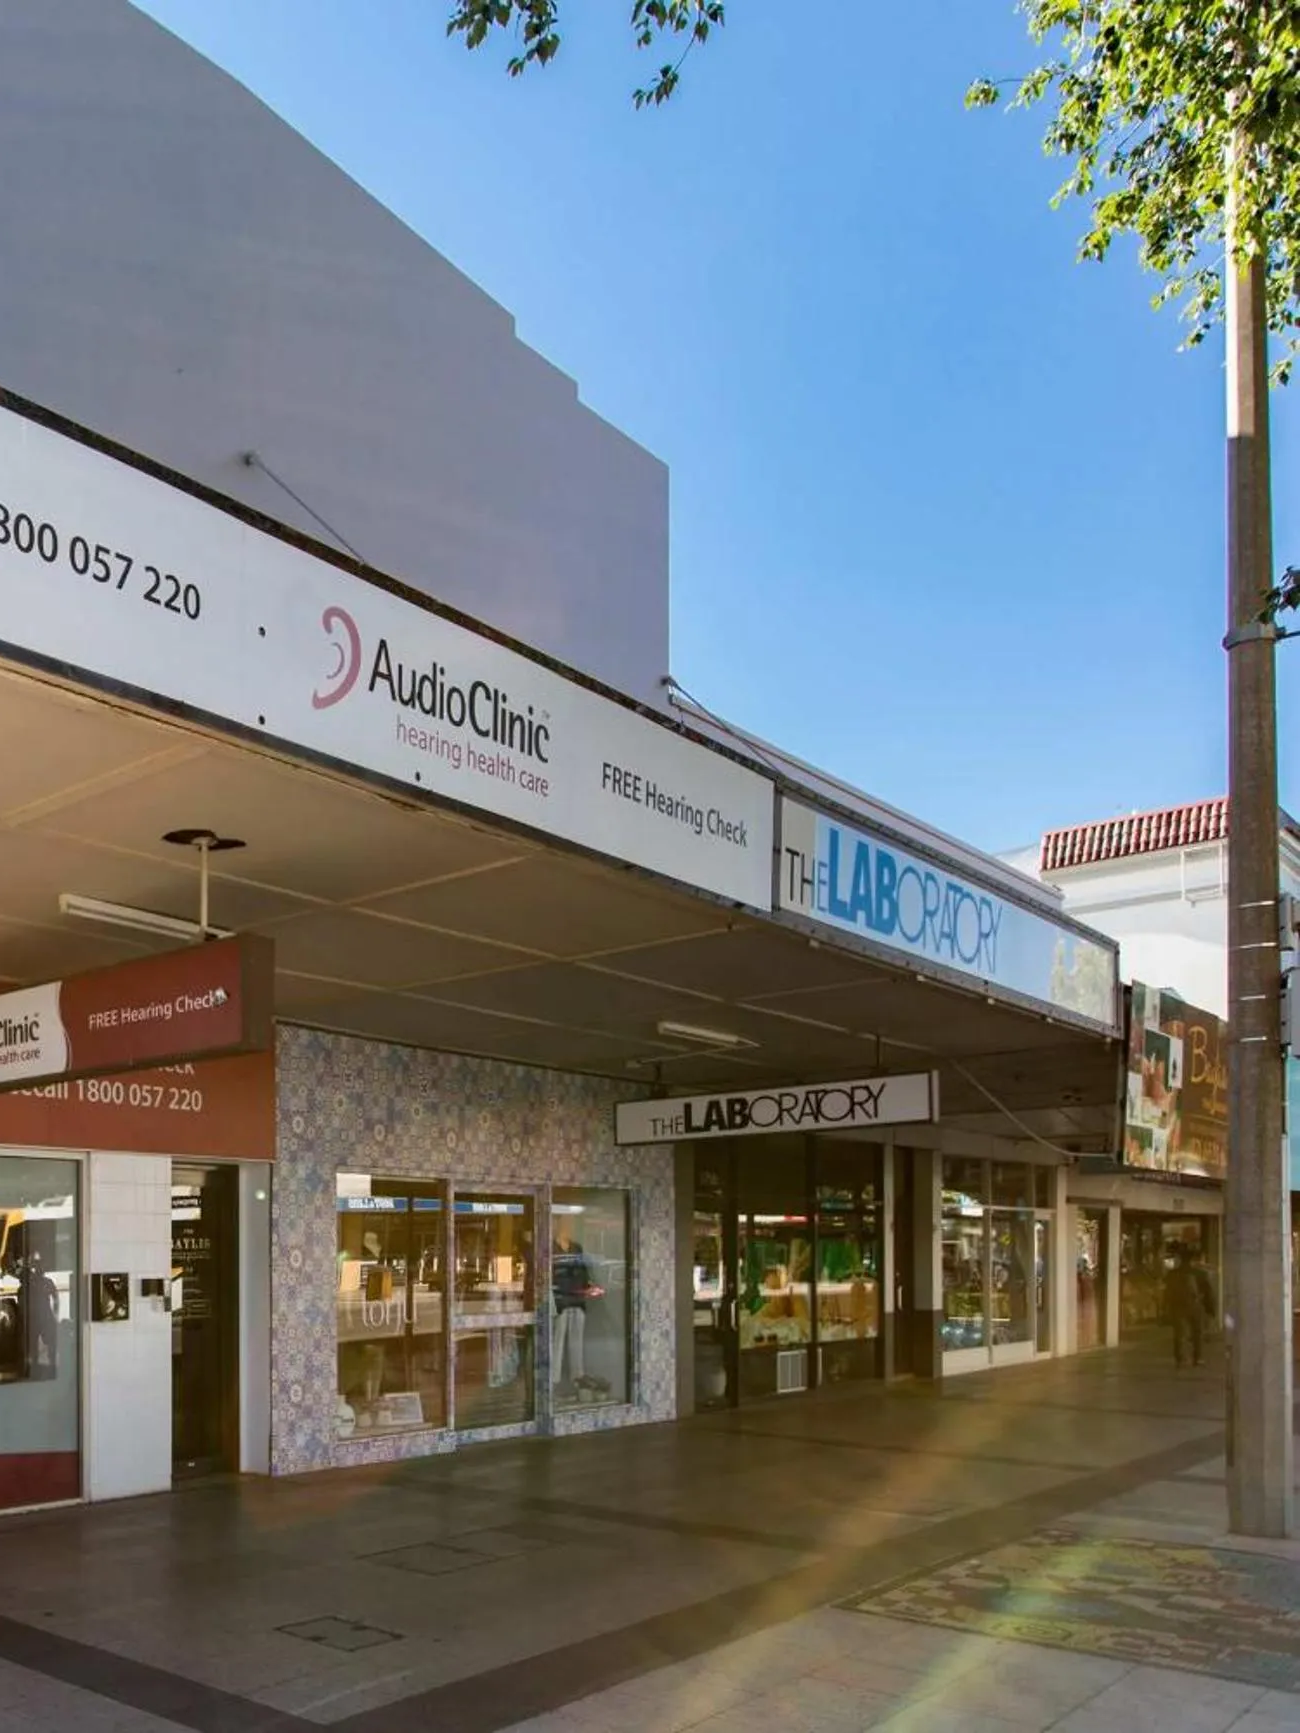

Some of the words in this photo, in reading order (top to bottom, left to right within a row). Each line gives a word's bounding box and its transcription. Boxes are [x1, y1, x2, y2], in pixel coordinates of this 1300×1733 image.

[70, 535, 132, 590] 057
[144, 565, 202, 621] 220
[368, 638, 550, 764] AudioClinic
[395, 714, 463, 770] hearing
[465, 740, 516, 785] health
[518, 765, 550, 798] care
[601, 761, 641, 805] FREE
[645, 779, 704, 836] Hearing
[706, 808, 748, 848] Check
[21, 1047, 41, 1061] care
[88, 1013, 118, 1031] FREE
[121, 1000, 173, 1024] Hearing
[76, 1079, 124, 1104] 1800
[128, 1084, 164, 1108] 057
[168, 1088, 203, 1112] 220
